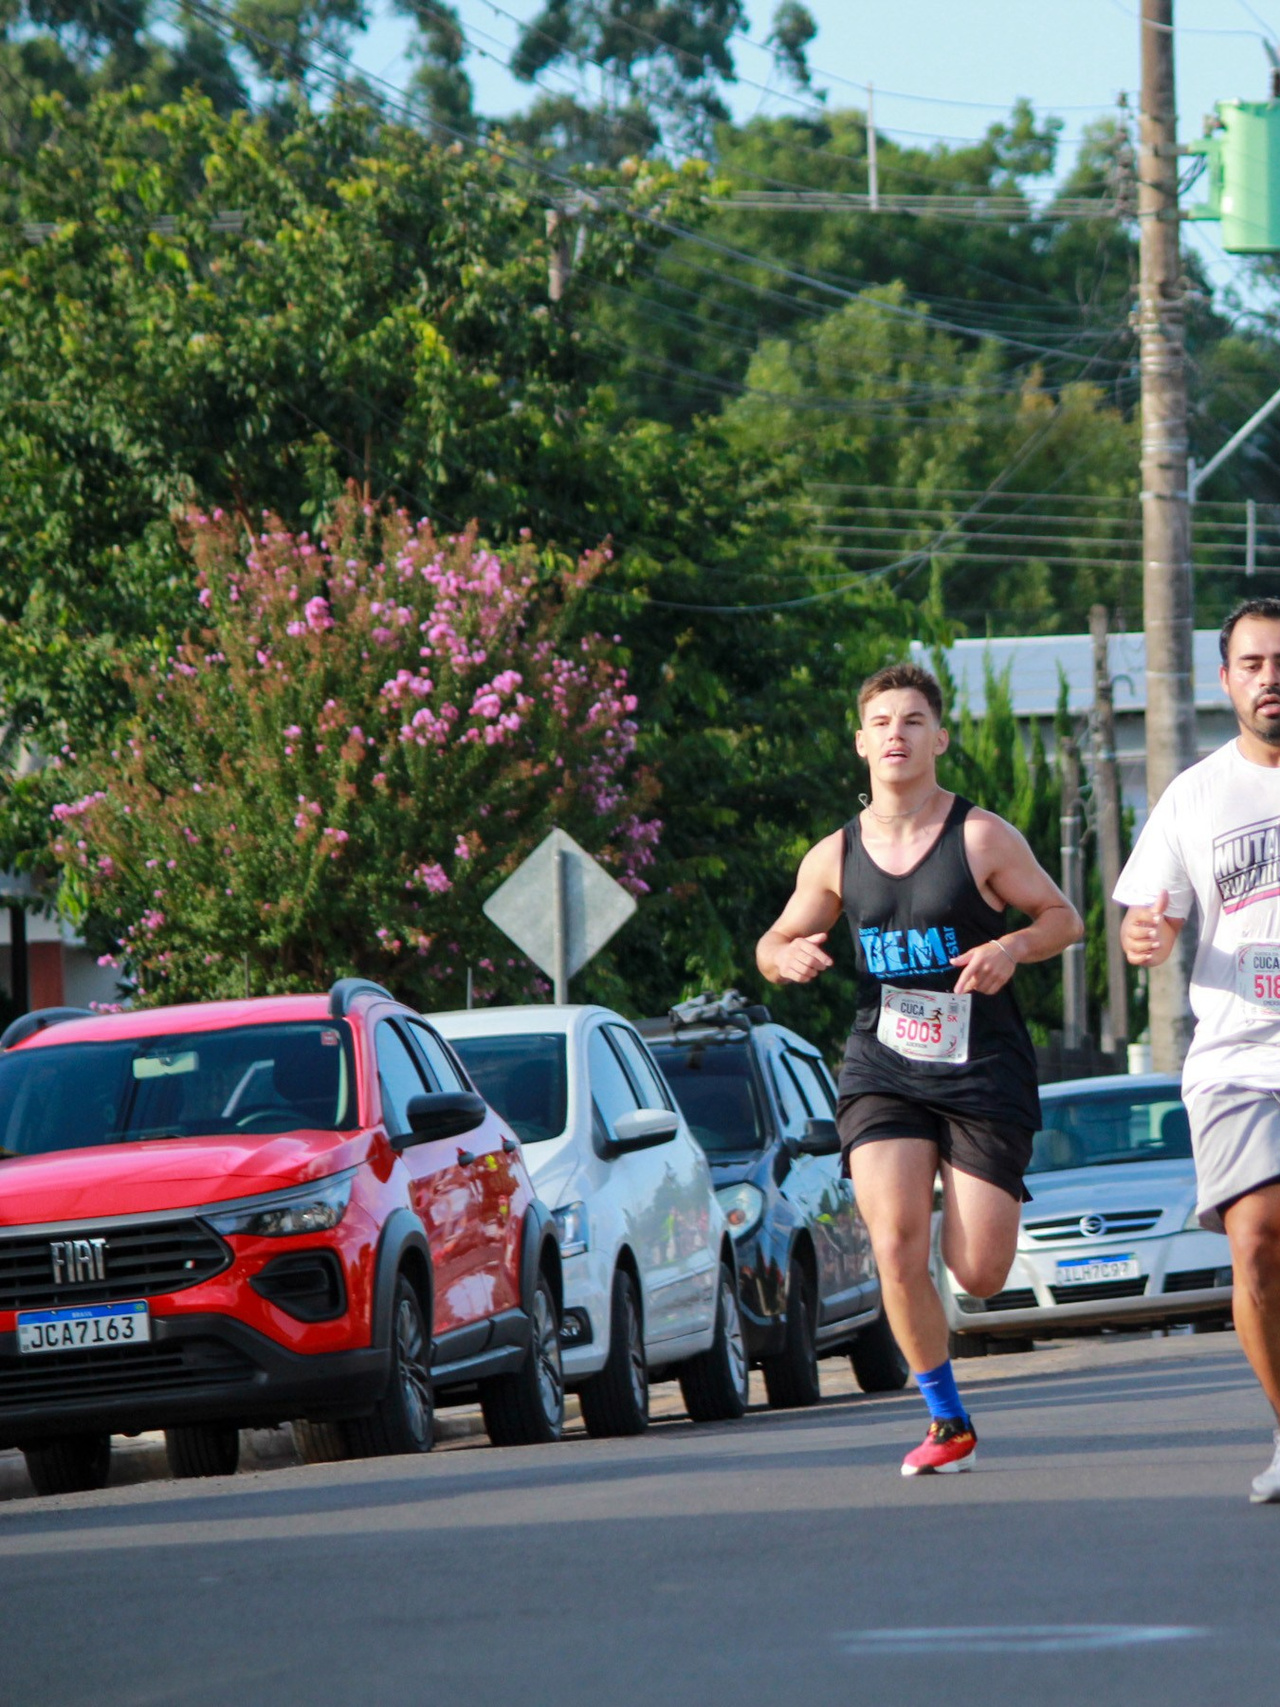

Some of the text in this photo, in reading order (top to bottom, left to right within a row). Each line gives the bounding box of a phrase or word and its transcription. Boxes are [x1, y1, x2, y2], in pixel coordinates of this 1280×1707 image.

[860, 926, 948, 973] BEM
[1253, 956, 1280, 970] CUCA
[900, 1002, 925, 1017] CUCA
[895, 1017, 942, 1044] 5003
[49, 1238, 107, 1284] FIAT
[31, 1316, 135, 1349] JCA7I63
